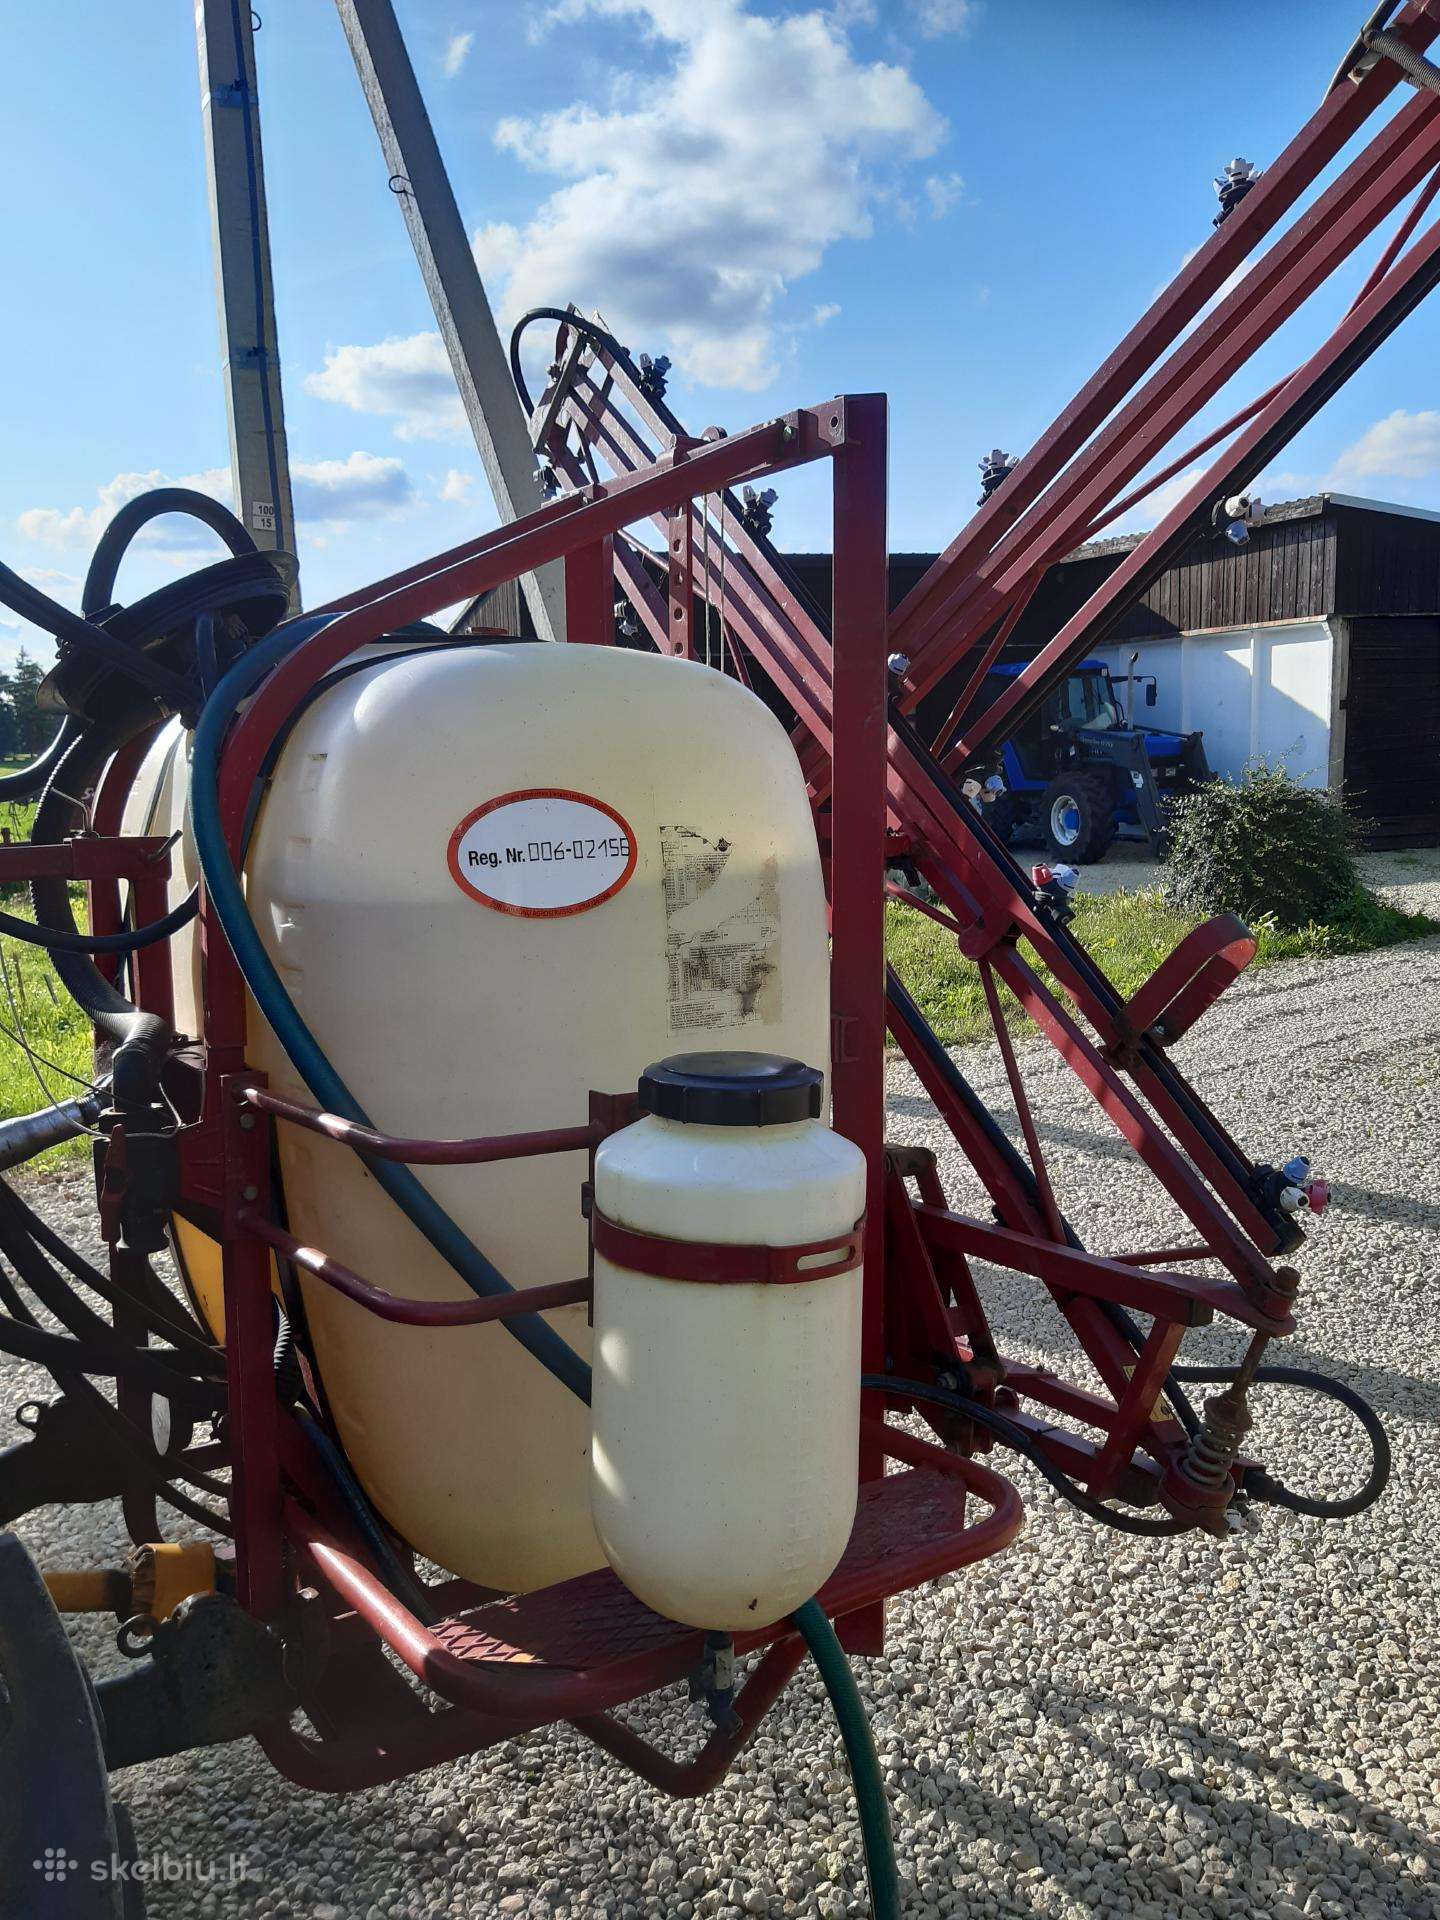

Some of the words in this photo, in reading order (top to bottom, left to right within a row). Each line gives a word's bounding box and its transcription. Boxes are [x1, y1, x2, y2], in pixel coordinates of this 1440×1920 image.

[258, 505, 274, 516] 100
[261, 518, 272, 528] 15
[468, 850, 502, 868] Reg.
[506, 847, 526, 863] Nr.
